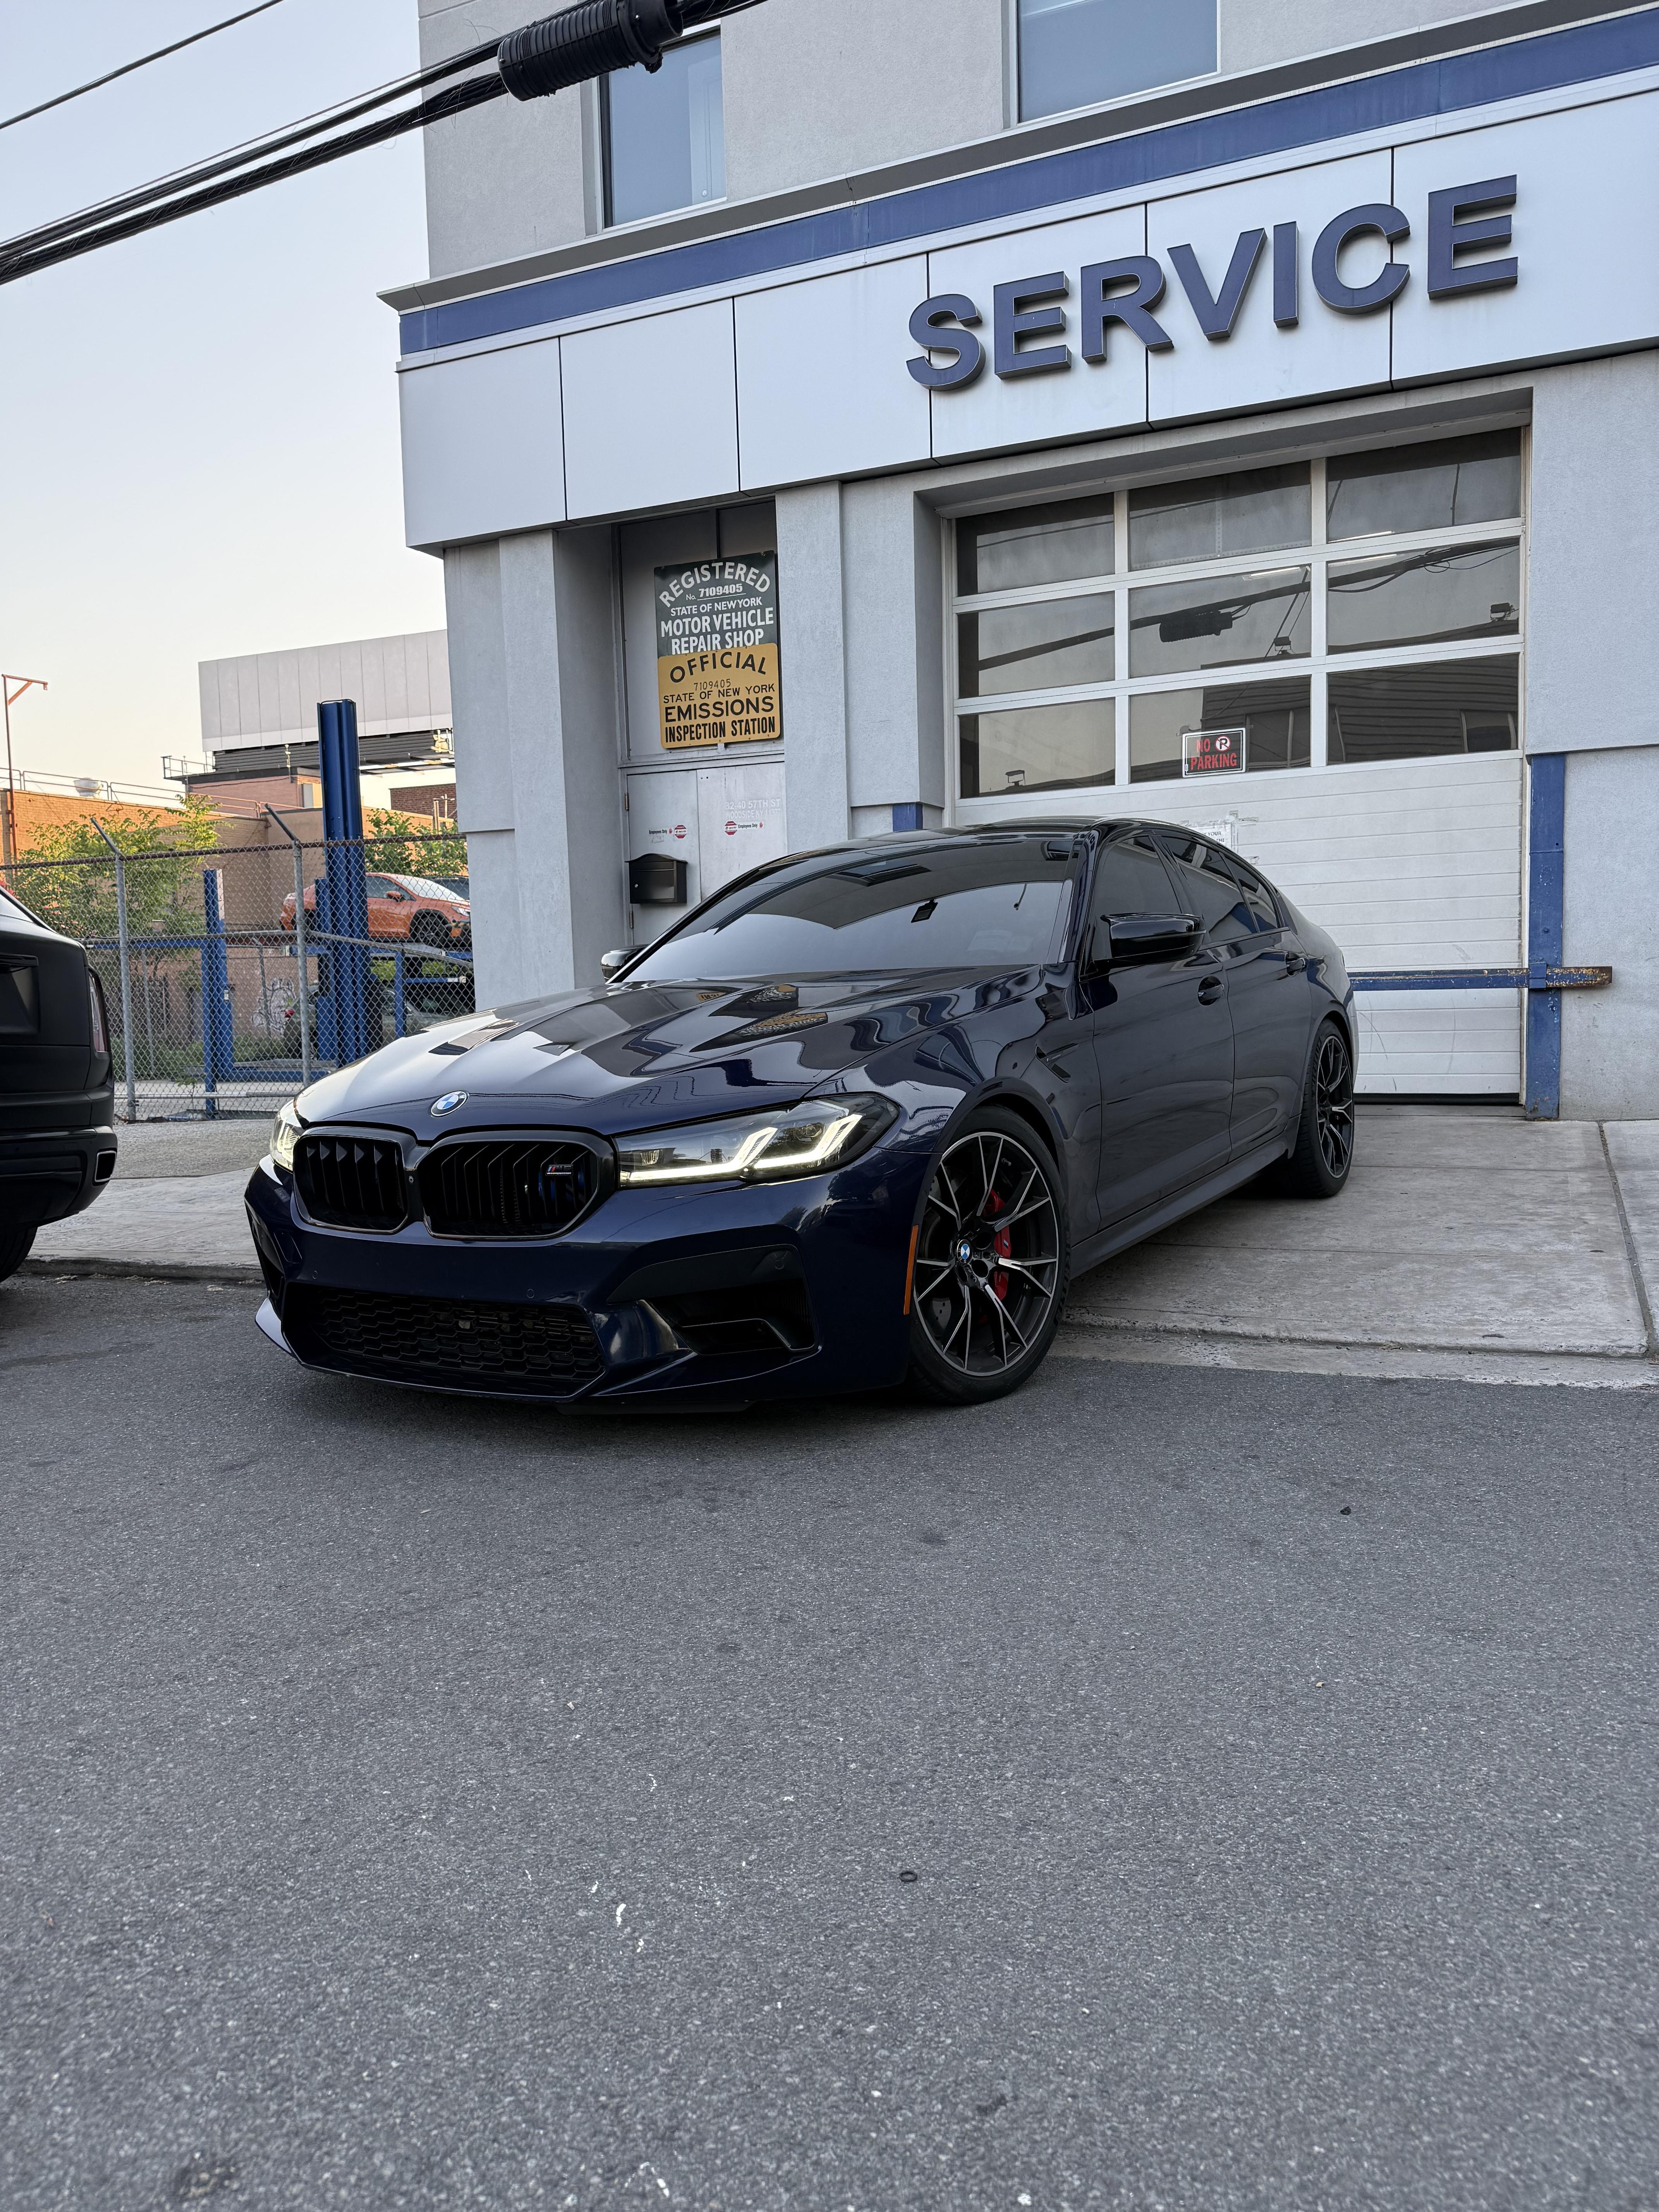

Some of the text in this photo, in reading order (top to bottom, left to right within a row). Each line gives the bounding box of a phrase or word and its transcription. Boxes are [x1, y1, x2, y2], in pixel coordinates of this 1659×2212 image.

[906, 175, 1518, 391] SERVICE
[659, 562, 770, 607] REGISTERED
[699, 583, 743, 597] 7109405
[670, 597, 762, 616] STATE OF NEW YORK
[661, 607, 774, 637] MOTOR VEHICLE
[672, 629, 764, 655] REPAIR SHOP
[670, 652, 766, 683] OFFICIAL
[663, 684, 775, 703] STATE OF NEW YORK
[694, 678, 731, 691] 7109405
[665, 696, 774, 722] EMISSIONS
[666, 716, 775, 743] INSPECTION STATION
[1196, 738, 1210, 753] NO
[1190, 753, 1237, 770] PARKING
[748, 800, 768, 809] 57TH
[771, 799, 781, 807] ST
[726, 810, 754, 819] WOODSIDE
[756, 809, 764, 817] NY
